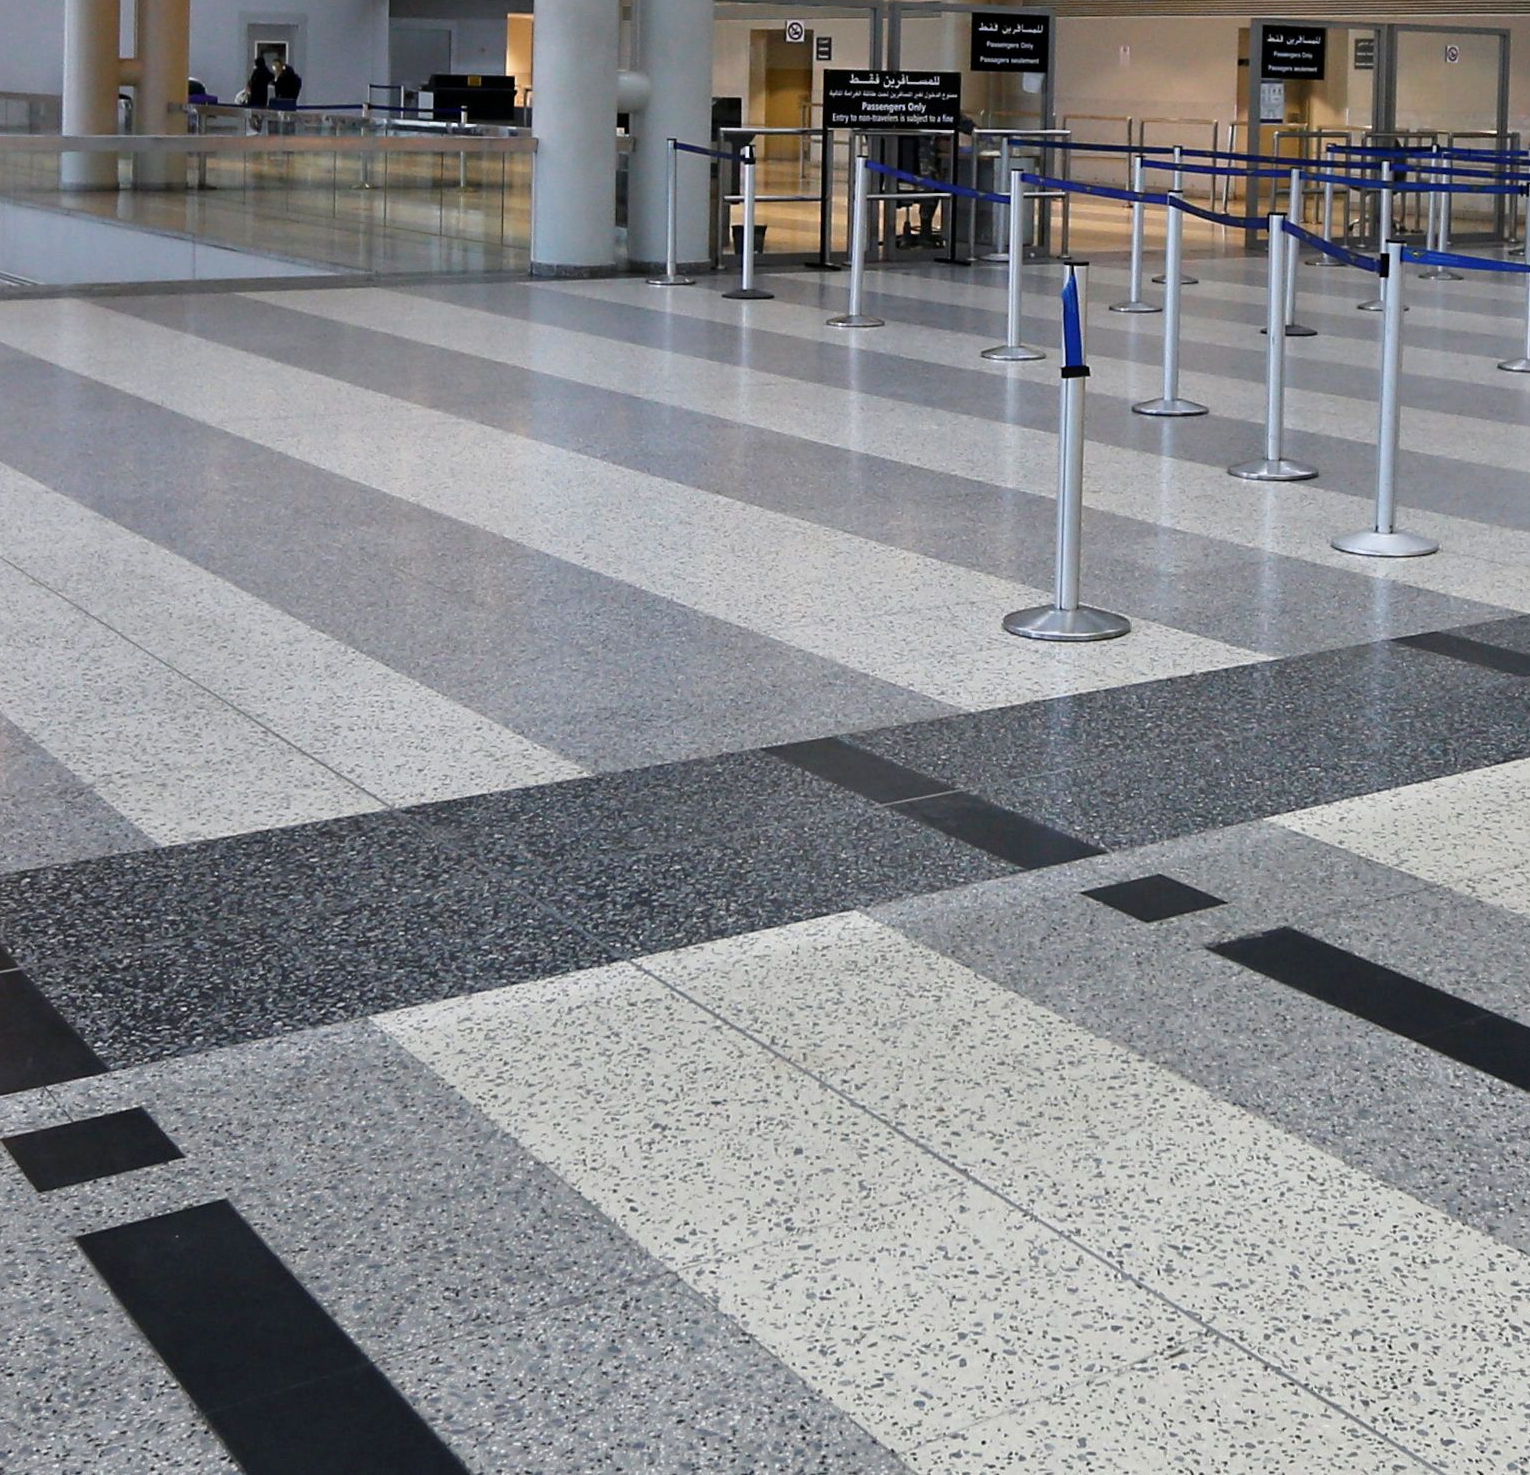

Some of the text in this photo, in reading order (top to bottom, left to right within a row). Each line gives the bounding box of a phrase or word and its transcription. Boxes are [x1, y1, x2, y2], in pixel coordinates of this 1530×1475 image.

[986, 40, 1033, 50] Passengers Only
[849, 73, 940, 88] للمسافرين فقط
[862, 101, 926, 113] Passengers Only
[832, 113, 849, 124] Entry
[850, 114, 857, 122] to
[900, 114, 905, 122] is
[907, 114, 928, 124] subject
[929, 114, 936, 122] to
[942, 114, 954, 123] fine
